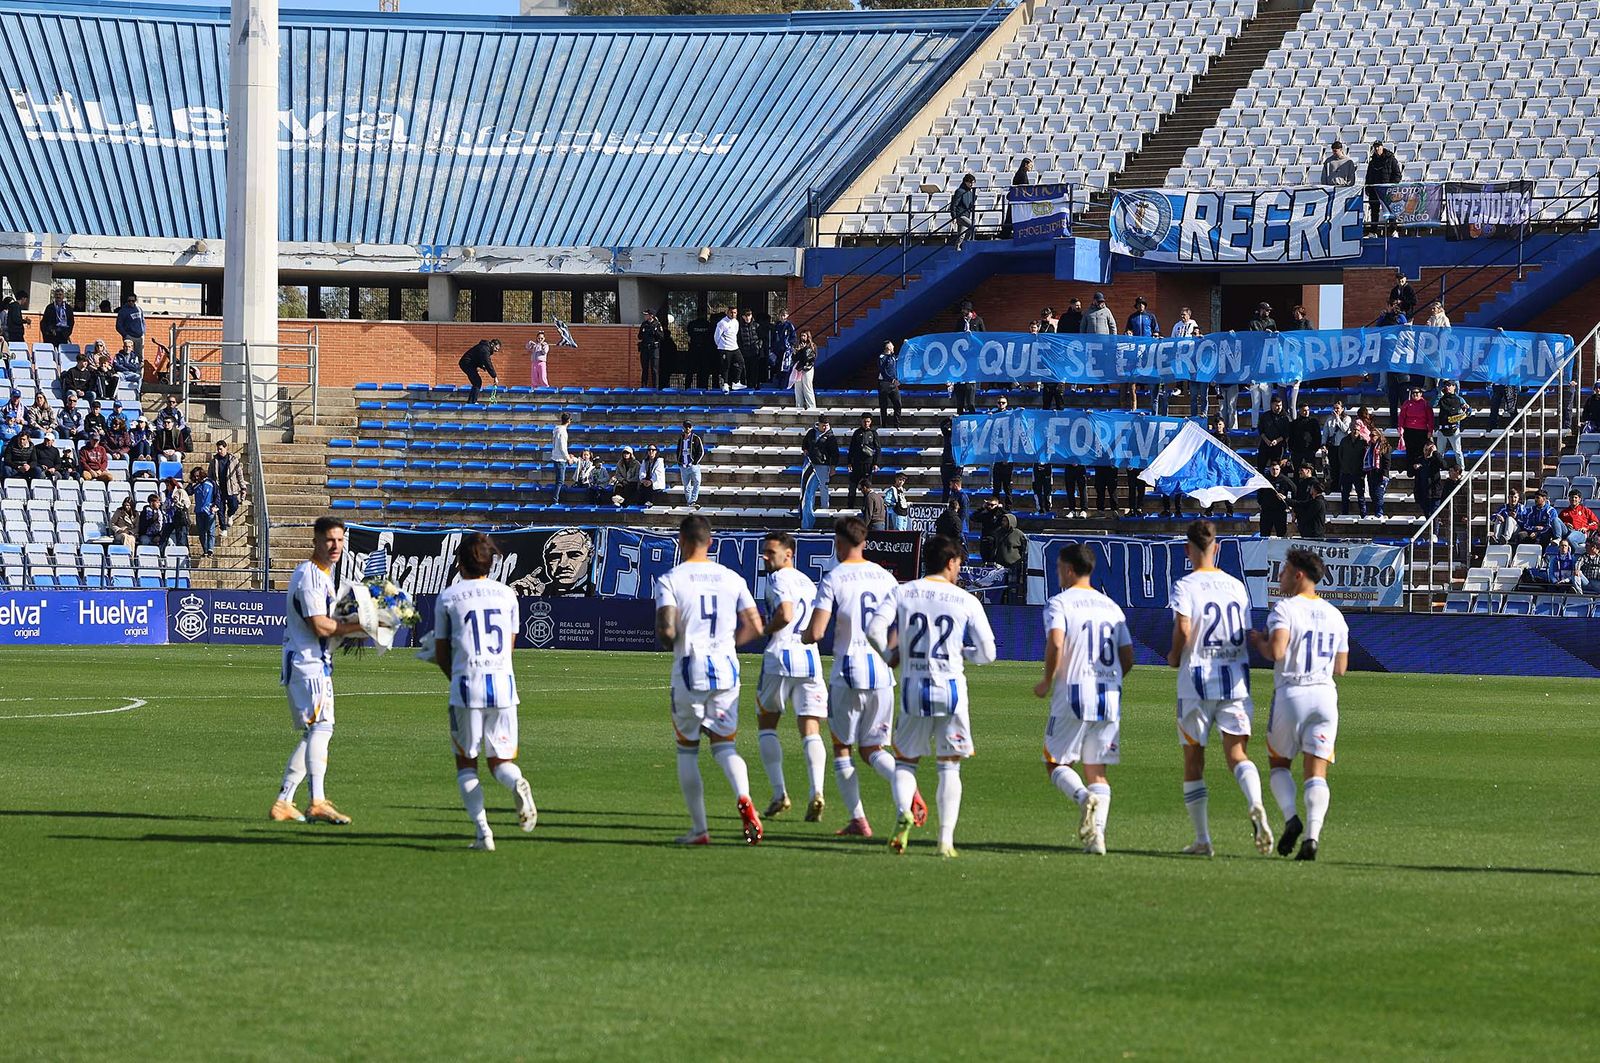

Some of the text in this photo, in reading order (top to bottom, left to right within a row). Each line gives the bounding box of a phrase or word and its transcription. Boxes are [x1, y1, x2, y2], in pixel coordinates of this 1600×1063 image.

[9, 86, 410, 145] Hueva
[1178, 186, 1364, 262] RECRE
[902, 338, 970, 378] LOS
[978, 341, 1050, 377] QUE
[1066, 340, 1104, 378] SE
[1259, 332, 1382, 375] ARRIBA
[1391, 329, 1565, 377] APRIETAN
[1045, 415, 1179, 459] FOREVE
[599, 526, 835, 600] FRNE
[1322, 563, 1396, 588] STERO
[79, 599, 148, 625] Huelva
[214, 601, 264, 611] REAL CLUB
[700, 595, 717, 638] 4
[1203, 601, 1244, 646] 20
[14, 627, 40, 638] original
[124, 626, 149, 637] original
[213, 627, 264, 636] DE HUELVA
[464, 608, 503, 656] 15
[909, 612, 954, 660] 22
[1081, 620, 1114, 667] 16
[1303, 630, 1334, 673] 14
